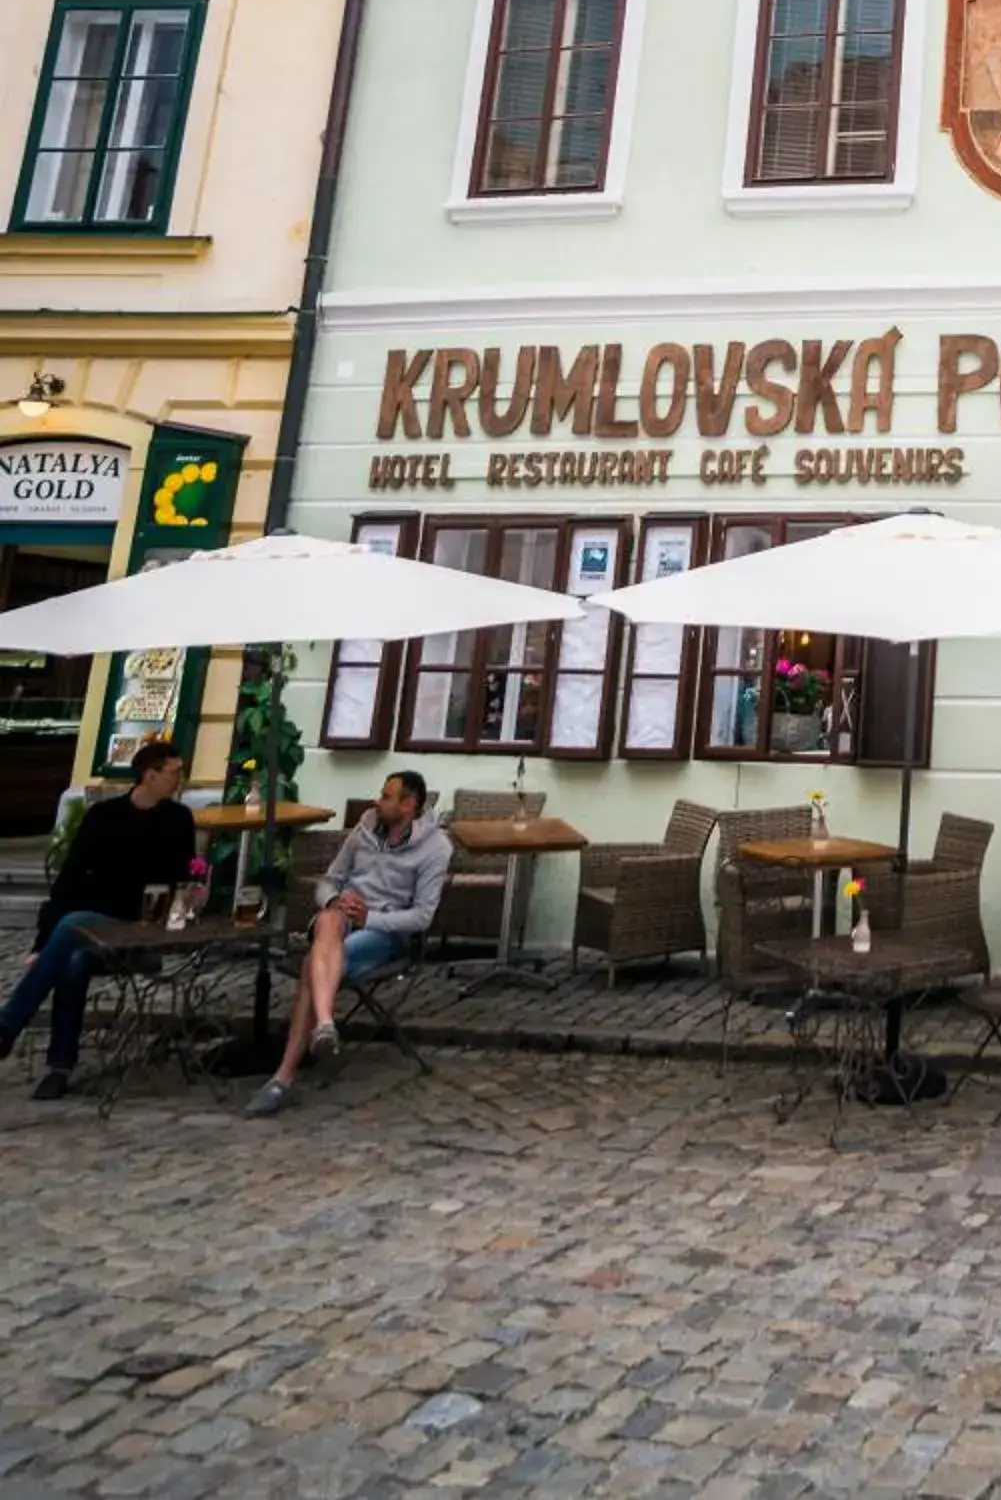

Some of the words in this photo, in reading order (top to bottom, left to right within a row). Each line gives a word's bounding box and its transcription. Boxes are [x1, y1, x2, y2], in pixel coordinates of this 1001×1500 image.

[376, 324, 904, 440] KRUMLOVSKÁ
[0, 452, 120, 478] NATALYA
[368, 453, 455, 489] HOTEL
[486, 449, 674, 488] RESTAURANT
[699, 443, 770, 485] CAFÉ
[794, 447, 965, 486] SOUVENIRS
[13, 478, 95, 500] GOLD
